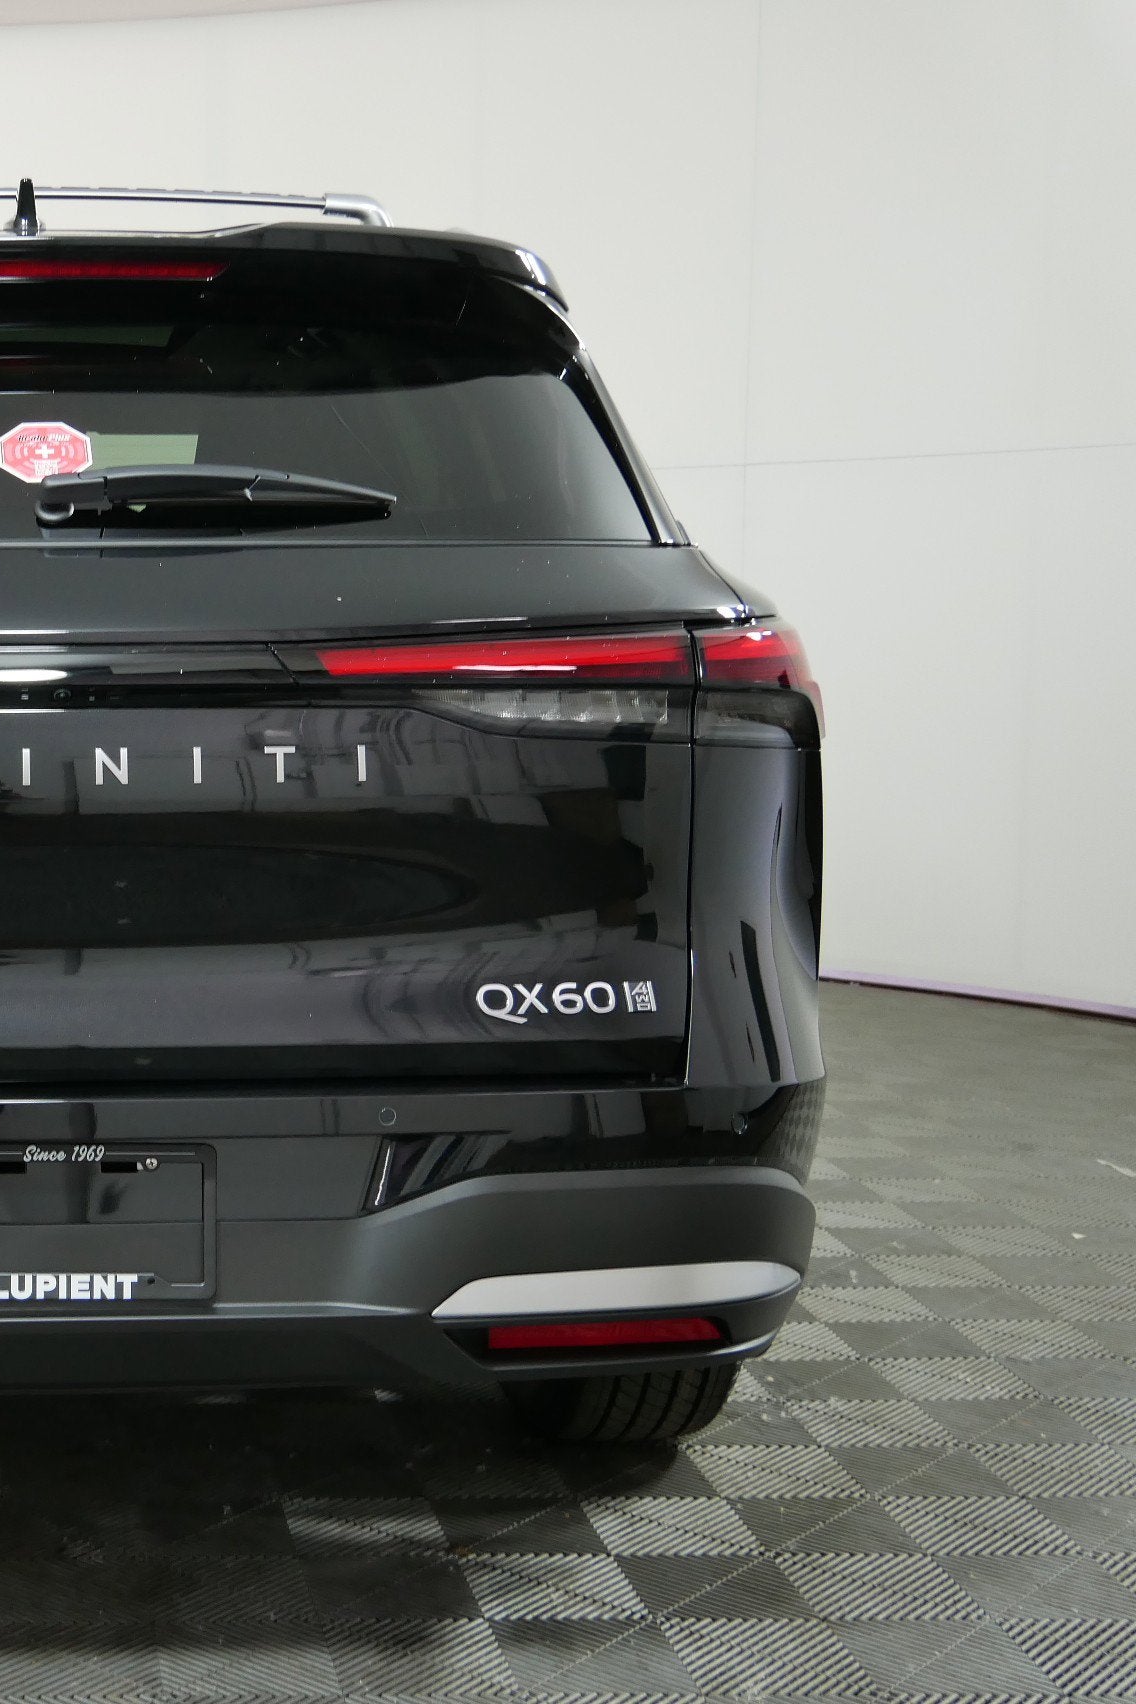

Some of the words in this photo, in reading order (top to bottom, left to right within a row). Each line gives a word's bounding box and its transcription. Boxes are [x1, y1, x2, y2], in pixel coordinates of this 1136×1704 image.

[476, 980, 616, 1025] QX60
[23, 1144, 66, 1162] Since
[71, 1144, 106, 1162] 1969
